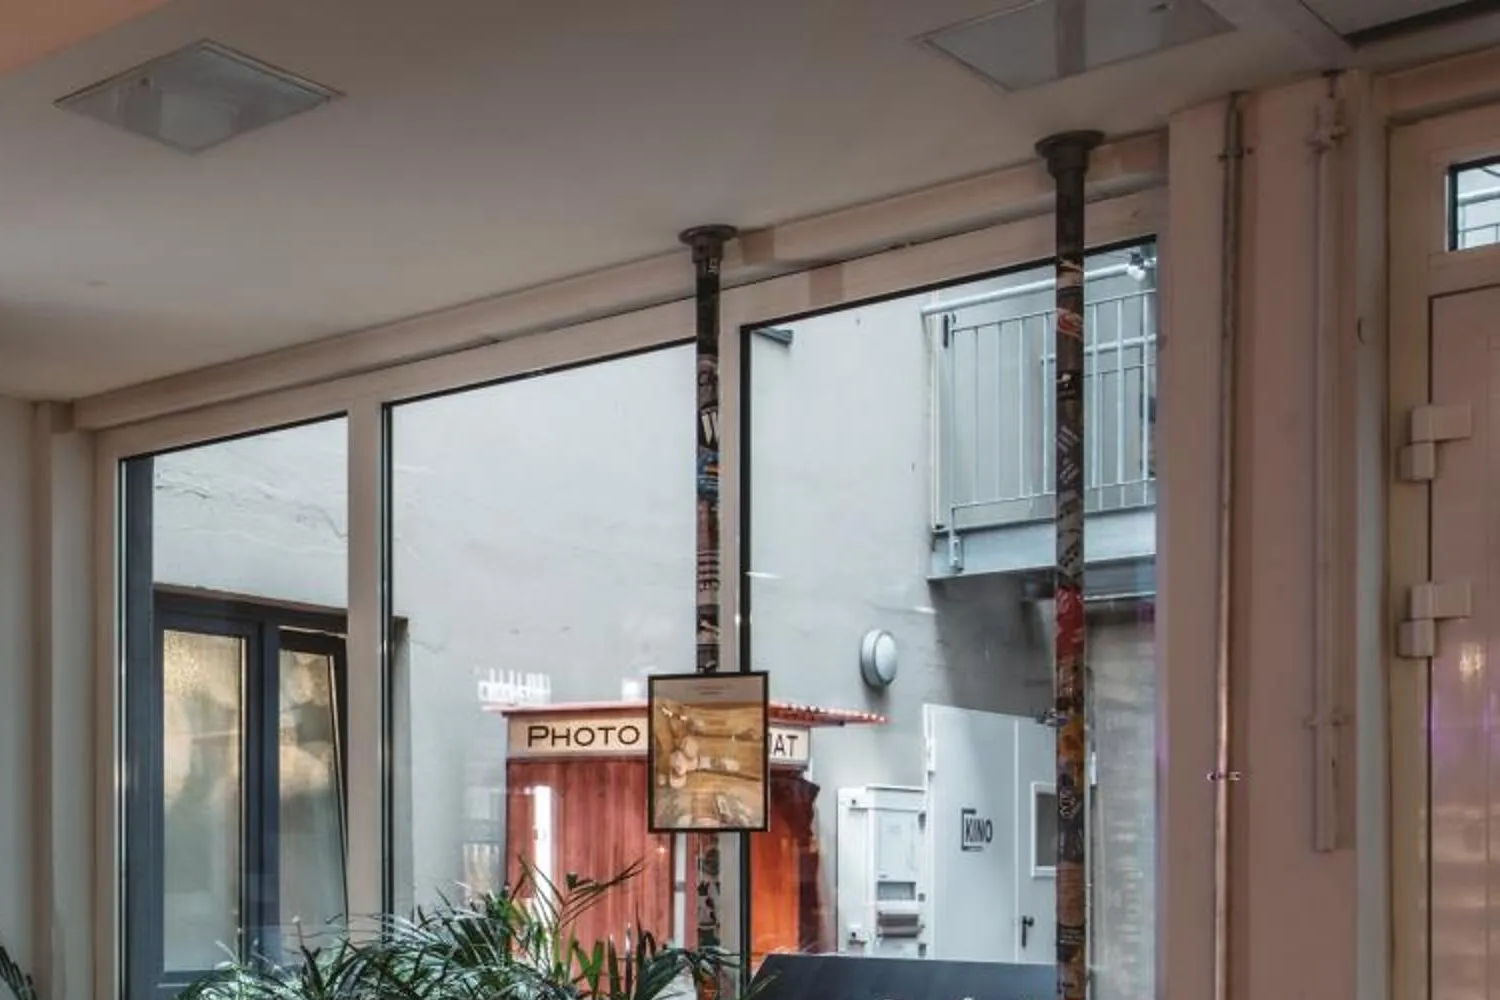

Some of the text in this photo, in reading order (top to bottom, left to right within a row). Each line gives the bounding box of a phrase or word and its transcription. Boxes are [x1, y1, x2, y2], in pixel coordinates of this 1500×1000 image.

[527, 725, 798, 756] PHOTO AT
[965, 819, 993, 843] KINO
